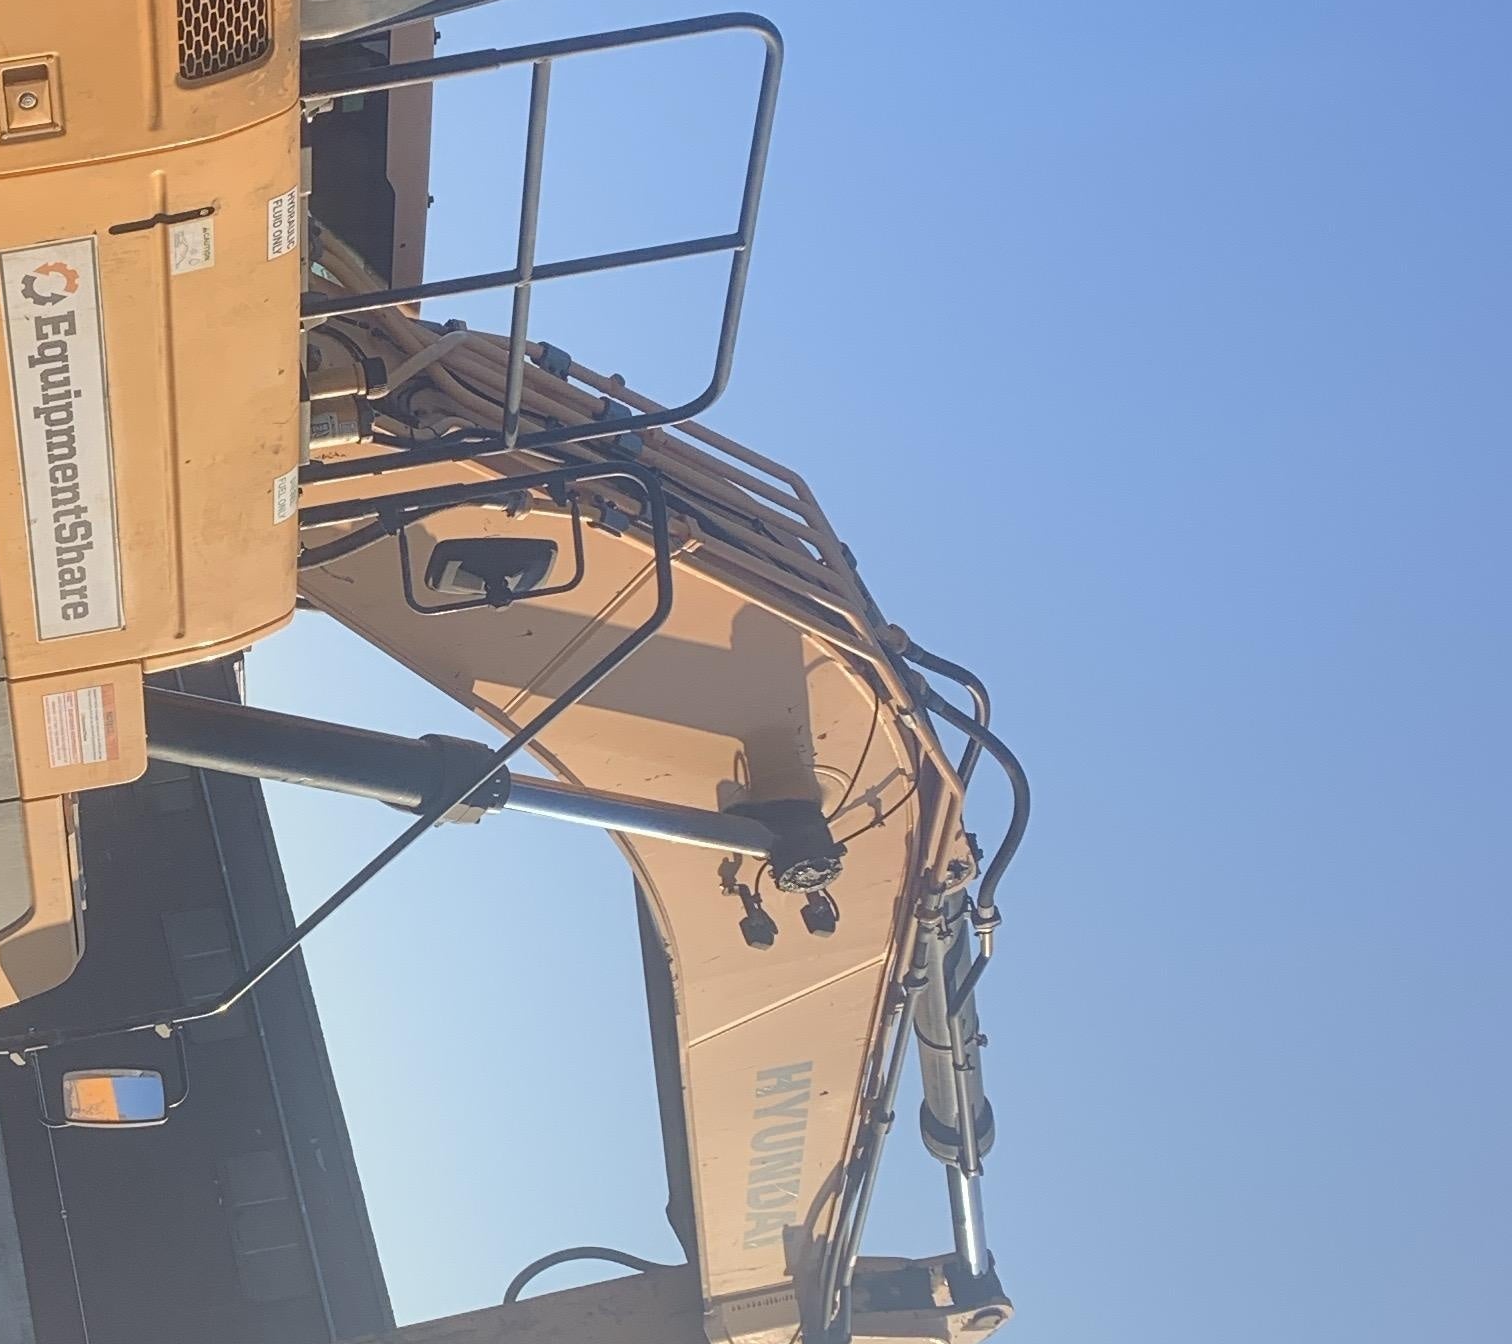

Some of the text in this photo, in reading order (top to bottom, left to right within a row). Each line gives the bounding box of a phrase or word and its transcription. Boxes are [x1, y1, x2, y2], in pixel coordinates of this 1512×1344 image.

[202, 232, 211, 262] CAUTION
[272, 199, 283, 255] FLUID ONLY
[286, 191, 297, 250] HYDRAULIC
[27, 309, 94, 622] EquipmentShare
[277, 477, 287, 519] FUEL ONLY
[743, 1060, 814, 1251] HYUNDAI
